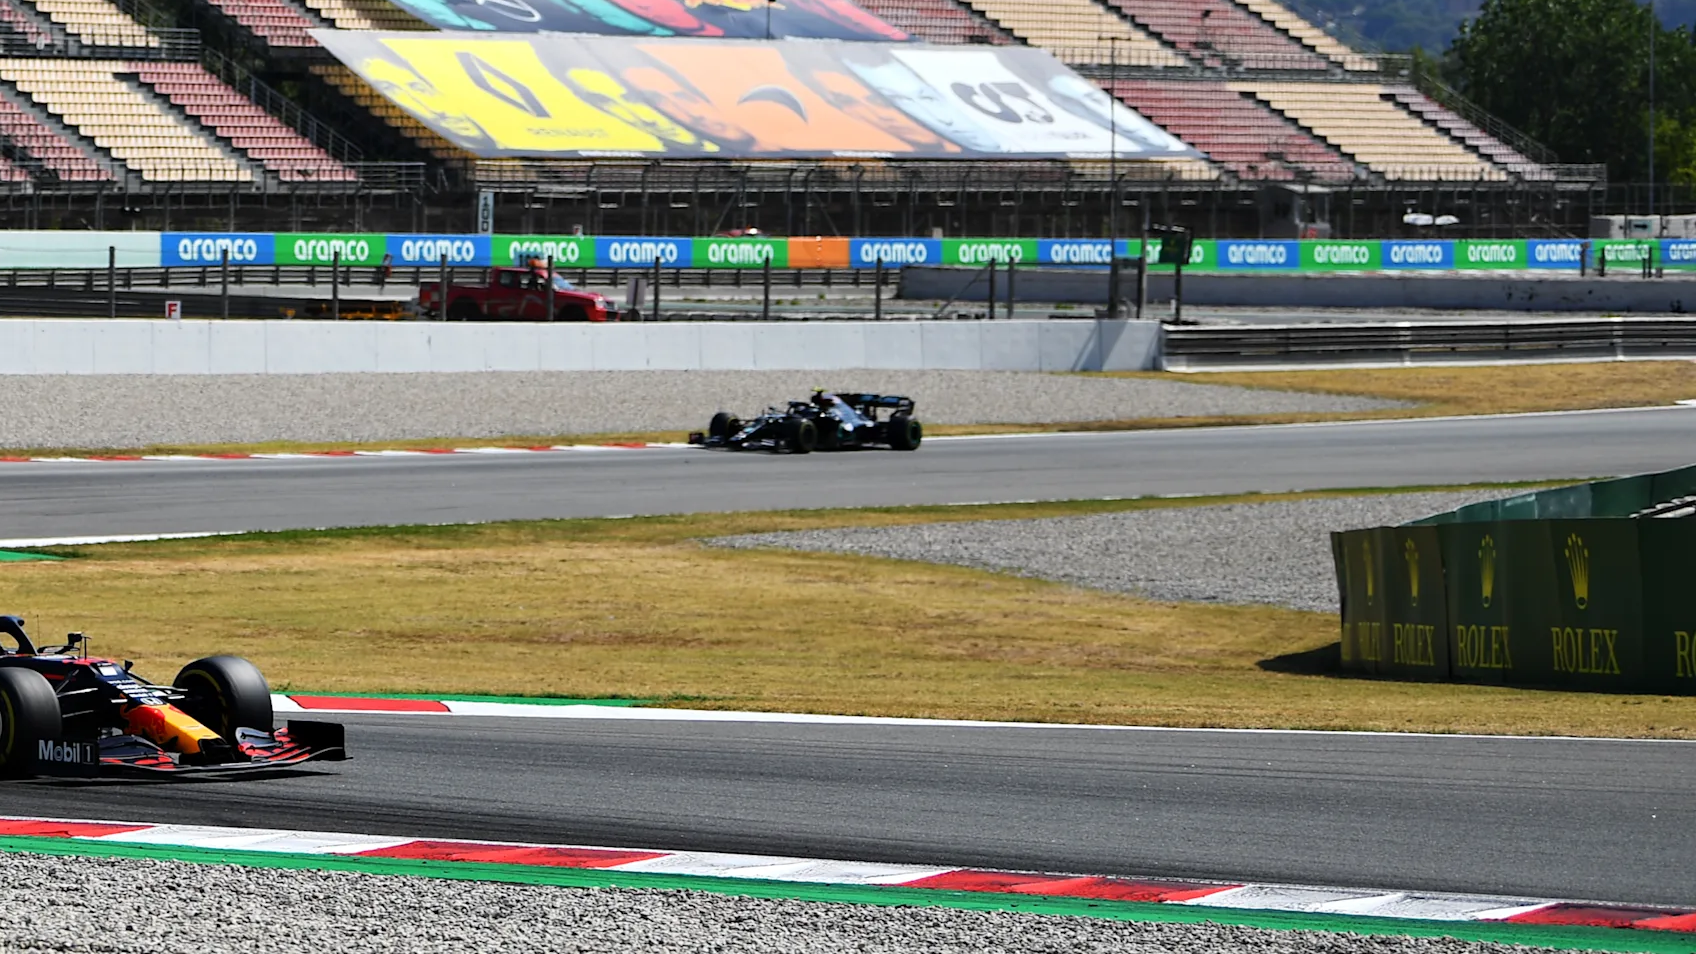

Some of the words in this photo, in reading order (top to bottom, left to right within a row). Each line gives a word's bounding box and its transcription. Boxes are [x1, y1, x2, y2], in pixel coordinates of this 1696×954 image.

[179, 238, 257, 261] aramco
[294, 239, 369, 262] aramco
[401, 239, 475, 262] aramco
[609, 242, 678, 263] aramco
[707, 243, 774, 263] aramco
[860, 243, 927, 263] aramco
[958, 244, 1023, 263] aramco
[1228, 245, 1286, 264] aramco
[1314, 245, 1369, 263] aramco
[1390, 245, 1443, 263] aramco
[1467, 244, 1516, 262] aramco
[167, 303, 178, 317] F
[1456, 624, 1512, 669] ROLEX
[1551, 626, 1621, 675] ROLEX
[38, 739, 81, 764] Mobil
